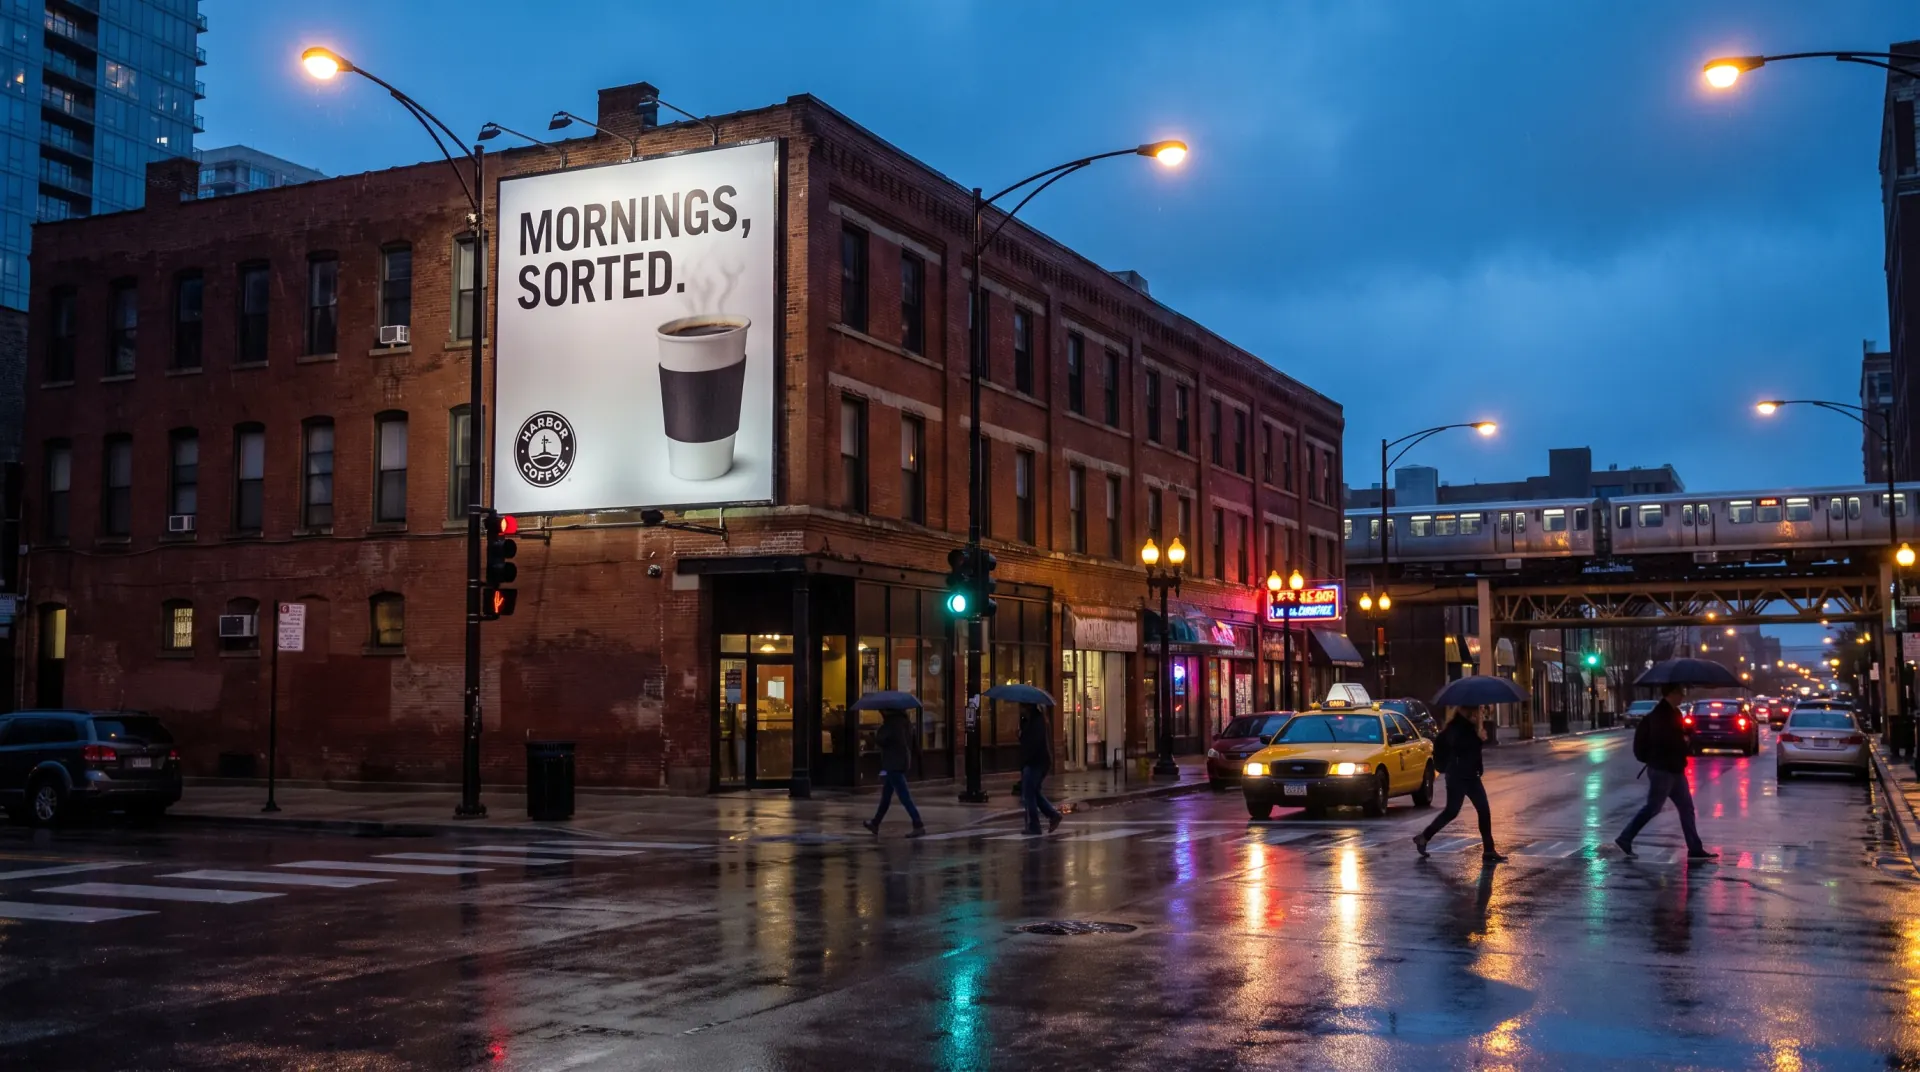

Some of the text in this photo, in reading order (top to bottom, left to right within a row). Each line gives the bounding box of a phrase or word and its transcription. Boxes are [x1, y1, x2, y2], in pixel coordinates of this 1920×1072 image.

[519, 185, 751, 256] MORNINGS,
[517, 250, 685, 310] SORTED.
[521, 416, 569, 442] HARBOR
[523, 459, 567, 481] COFFEE
